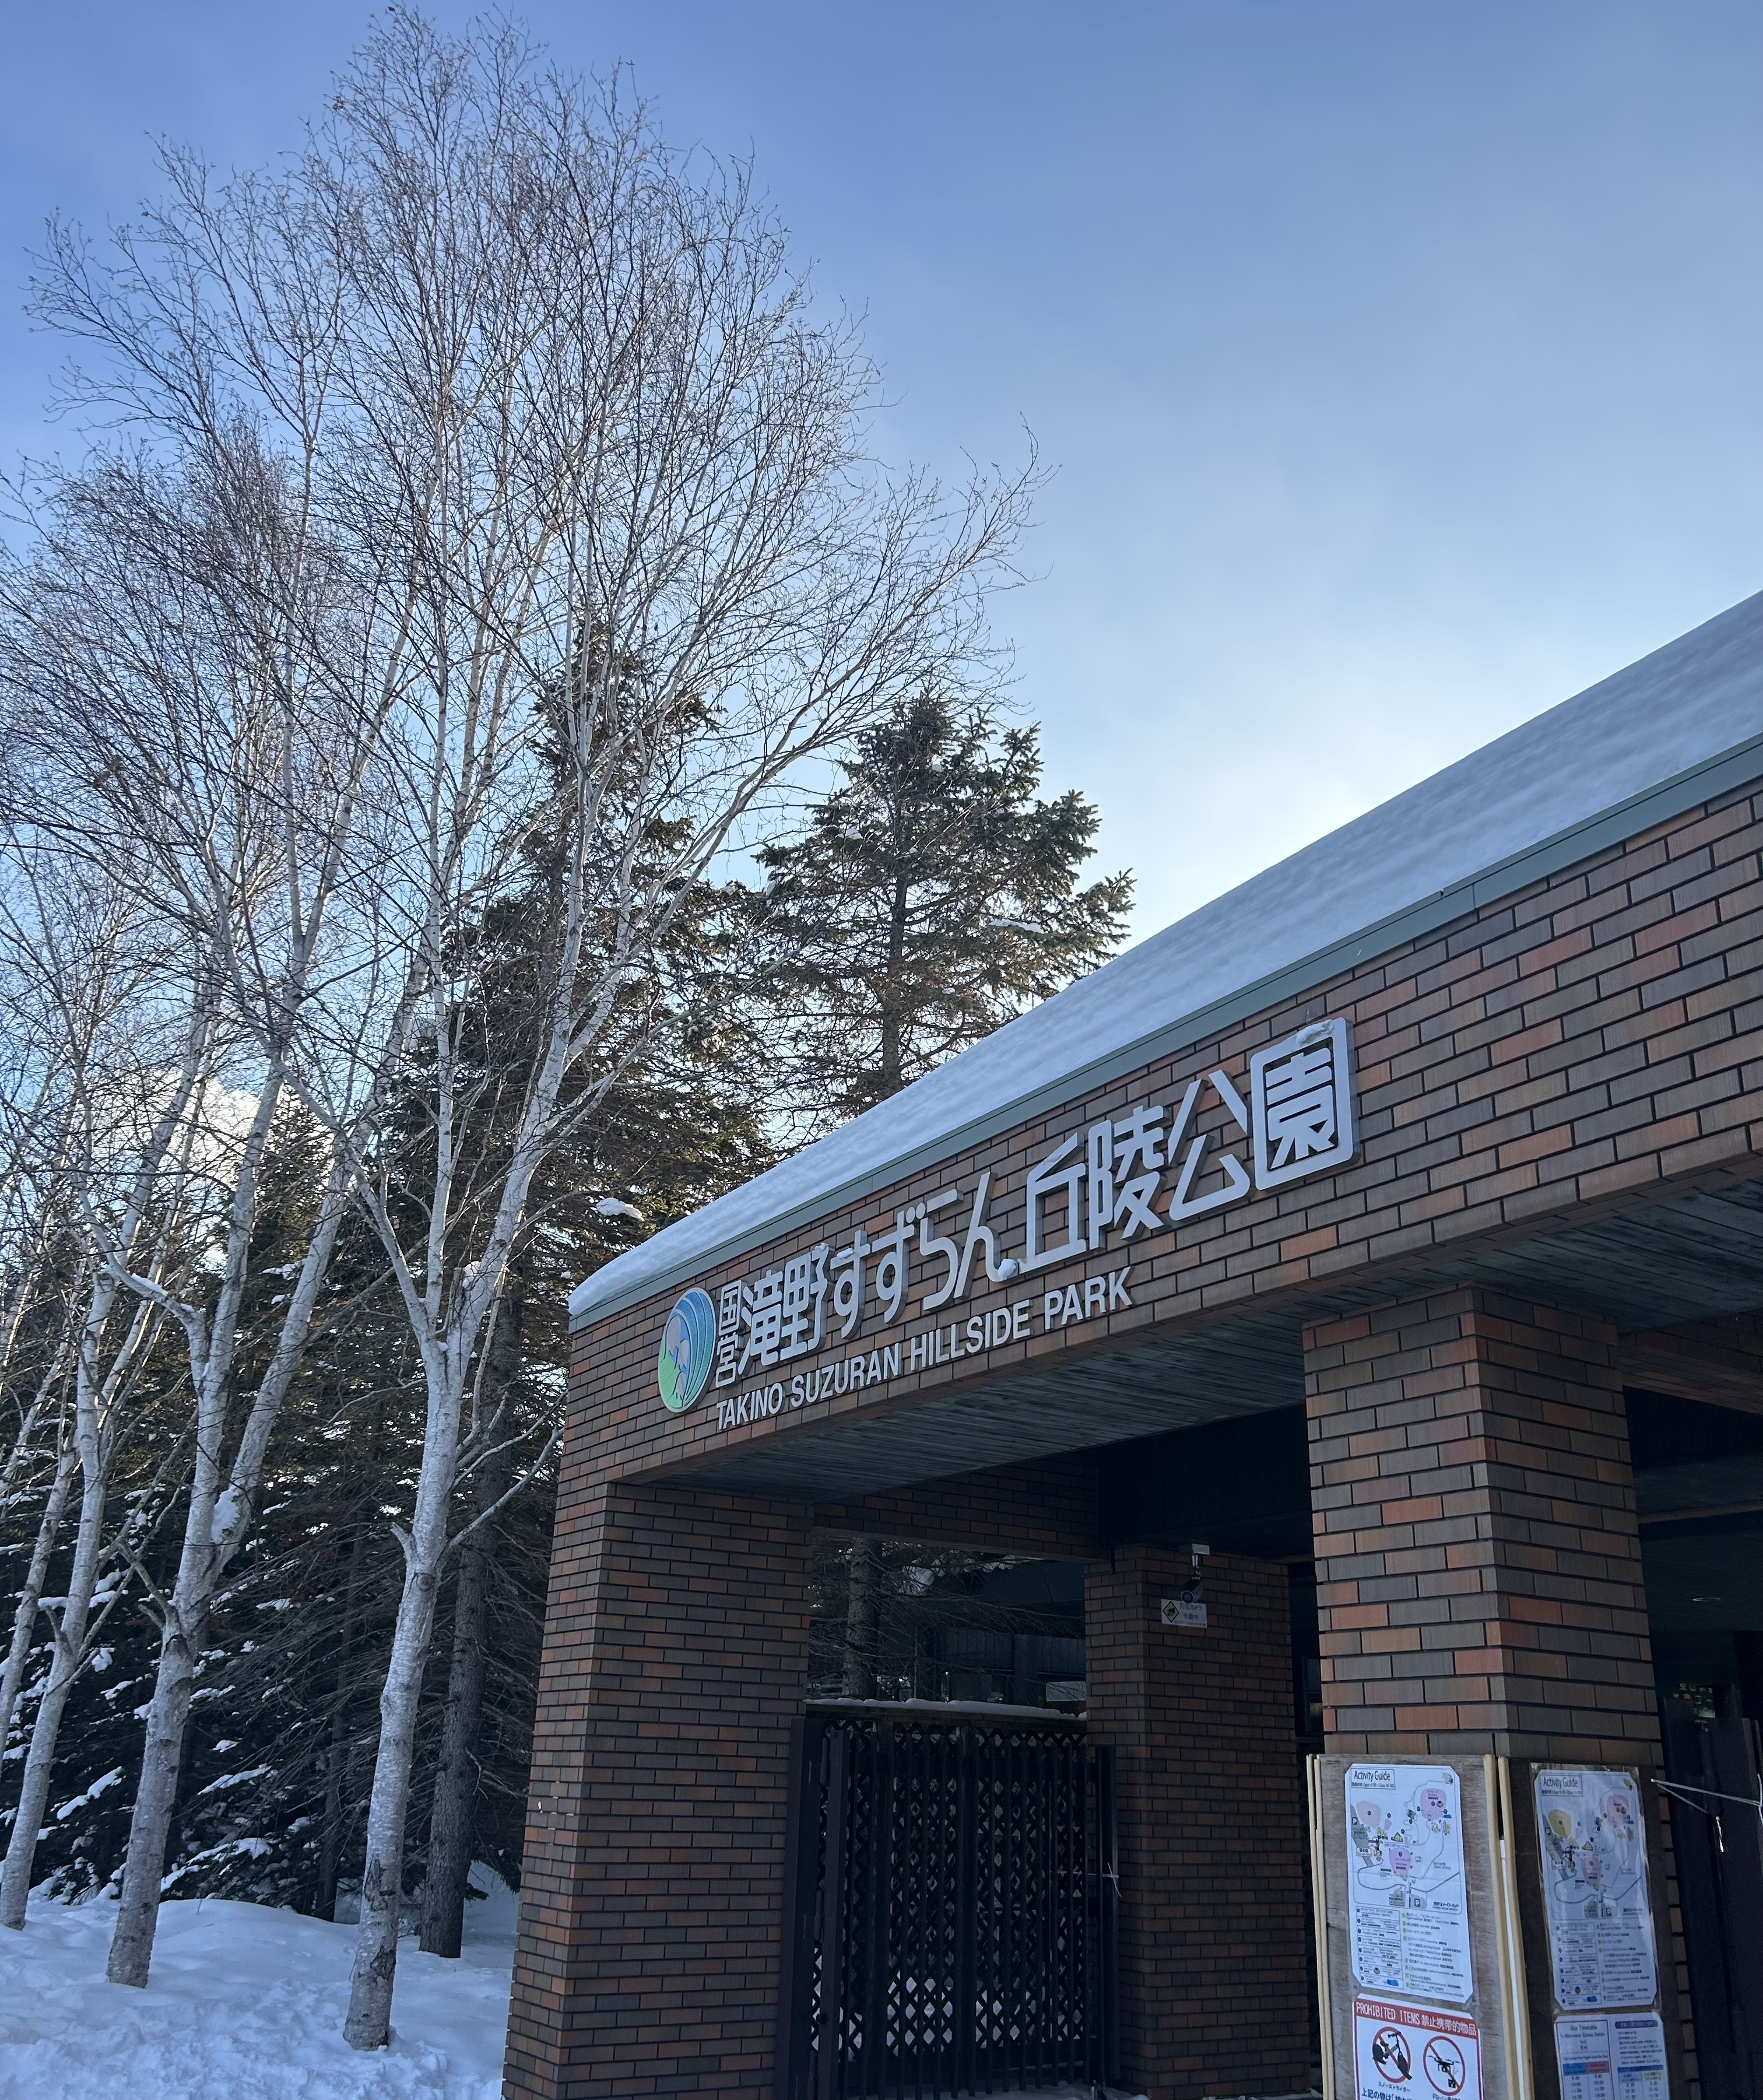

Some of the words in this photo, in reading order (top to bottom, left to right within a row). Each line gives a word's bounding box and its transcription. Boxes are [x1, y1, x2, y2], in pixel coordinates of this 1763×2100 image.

[715, 1280, 741, 1388] 国営
[739, 1017, 1357, 1375] 滝野すずらん丘陵公園
[717, 1382, 784, 1431] TAKINO
[791, 1343, 902, 1408] SUZURAN
[911, 1299, 1032, 1371] HILLSIDE
[1045, 1266, 1133, 1330] PARK
[1354, 1770, 1374, 1782] Activity
[1375, 1770, 1390, 1781] Guide
[1543, 1776, 1562, 1789] Activity
[1562, 1777, 1578, 1788] Guide
[1356, 2001, 1396, 2020] PROHIBITED
[1400, 2010, 1420, 2025] ITEMS
